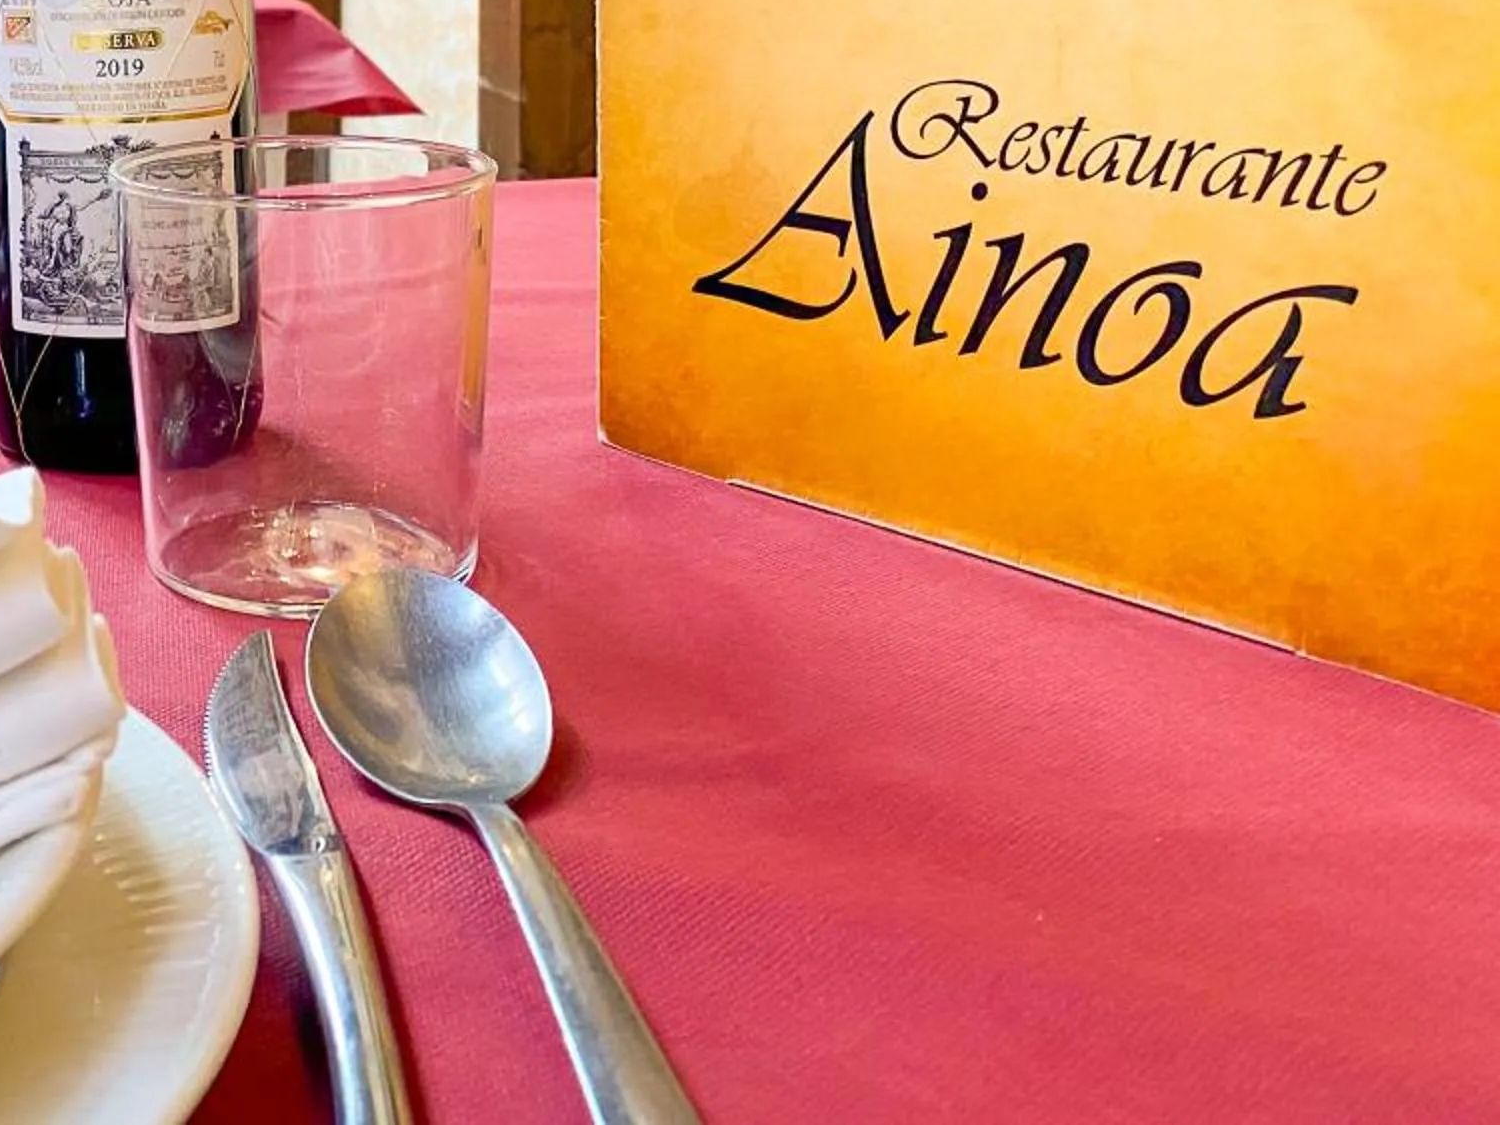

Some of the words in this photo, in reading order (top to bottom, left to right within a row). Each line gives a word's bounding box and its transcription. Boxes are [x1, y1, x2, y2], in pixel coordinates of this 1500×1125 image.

[96, 60, 145, 79] 2019
[890, 79, 1388, 217] Restaurante
[691, 110, 1359, 419] Ainoa
